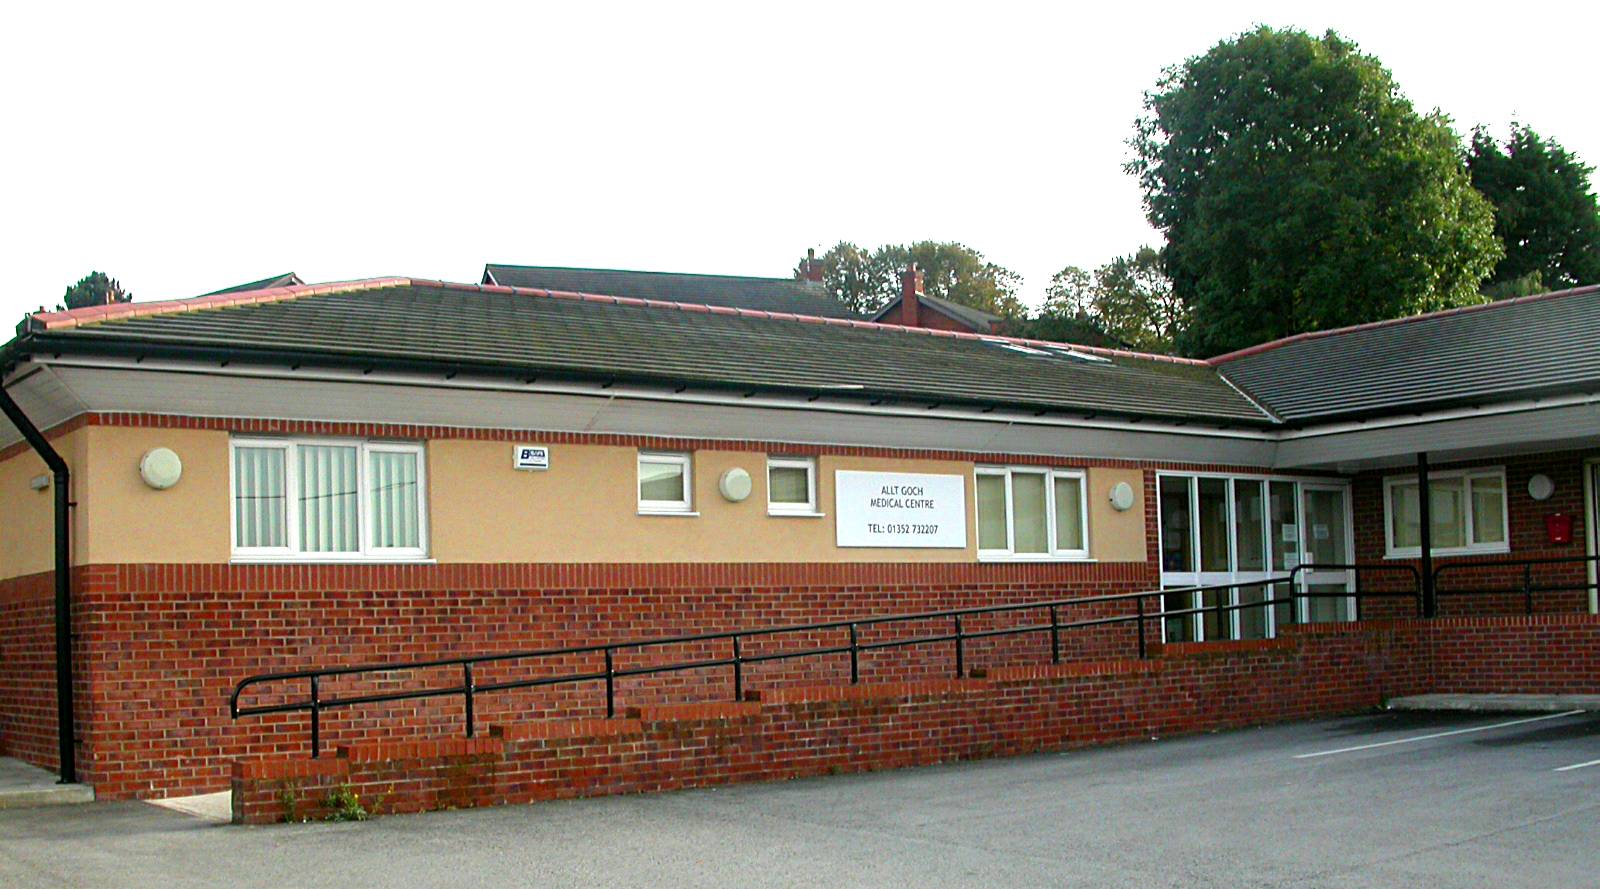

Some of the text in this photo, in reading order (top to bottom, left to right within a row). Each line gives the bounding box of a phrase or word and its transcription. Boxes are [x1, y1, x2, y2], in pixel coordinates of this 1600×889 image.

[881, 486, 924, 496] ALLT GOCH
[870, 498, 934, 509] MEDICAL CENTRE
[868, 523, 938, 534] TEL: 01352 732207
